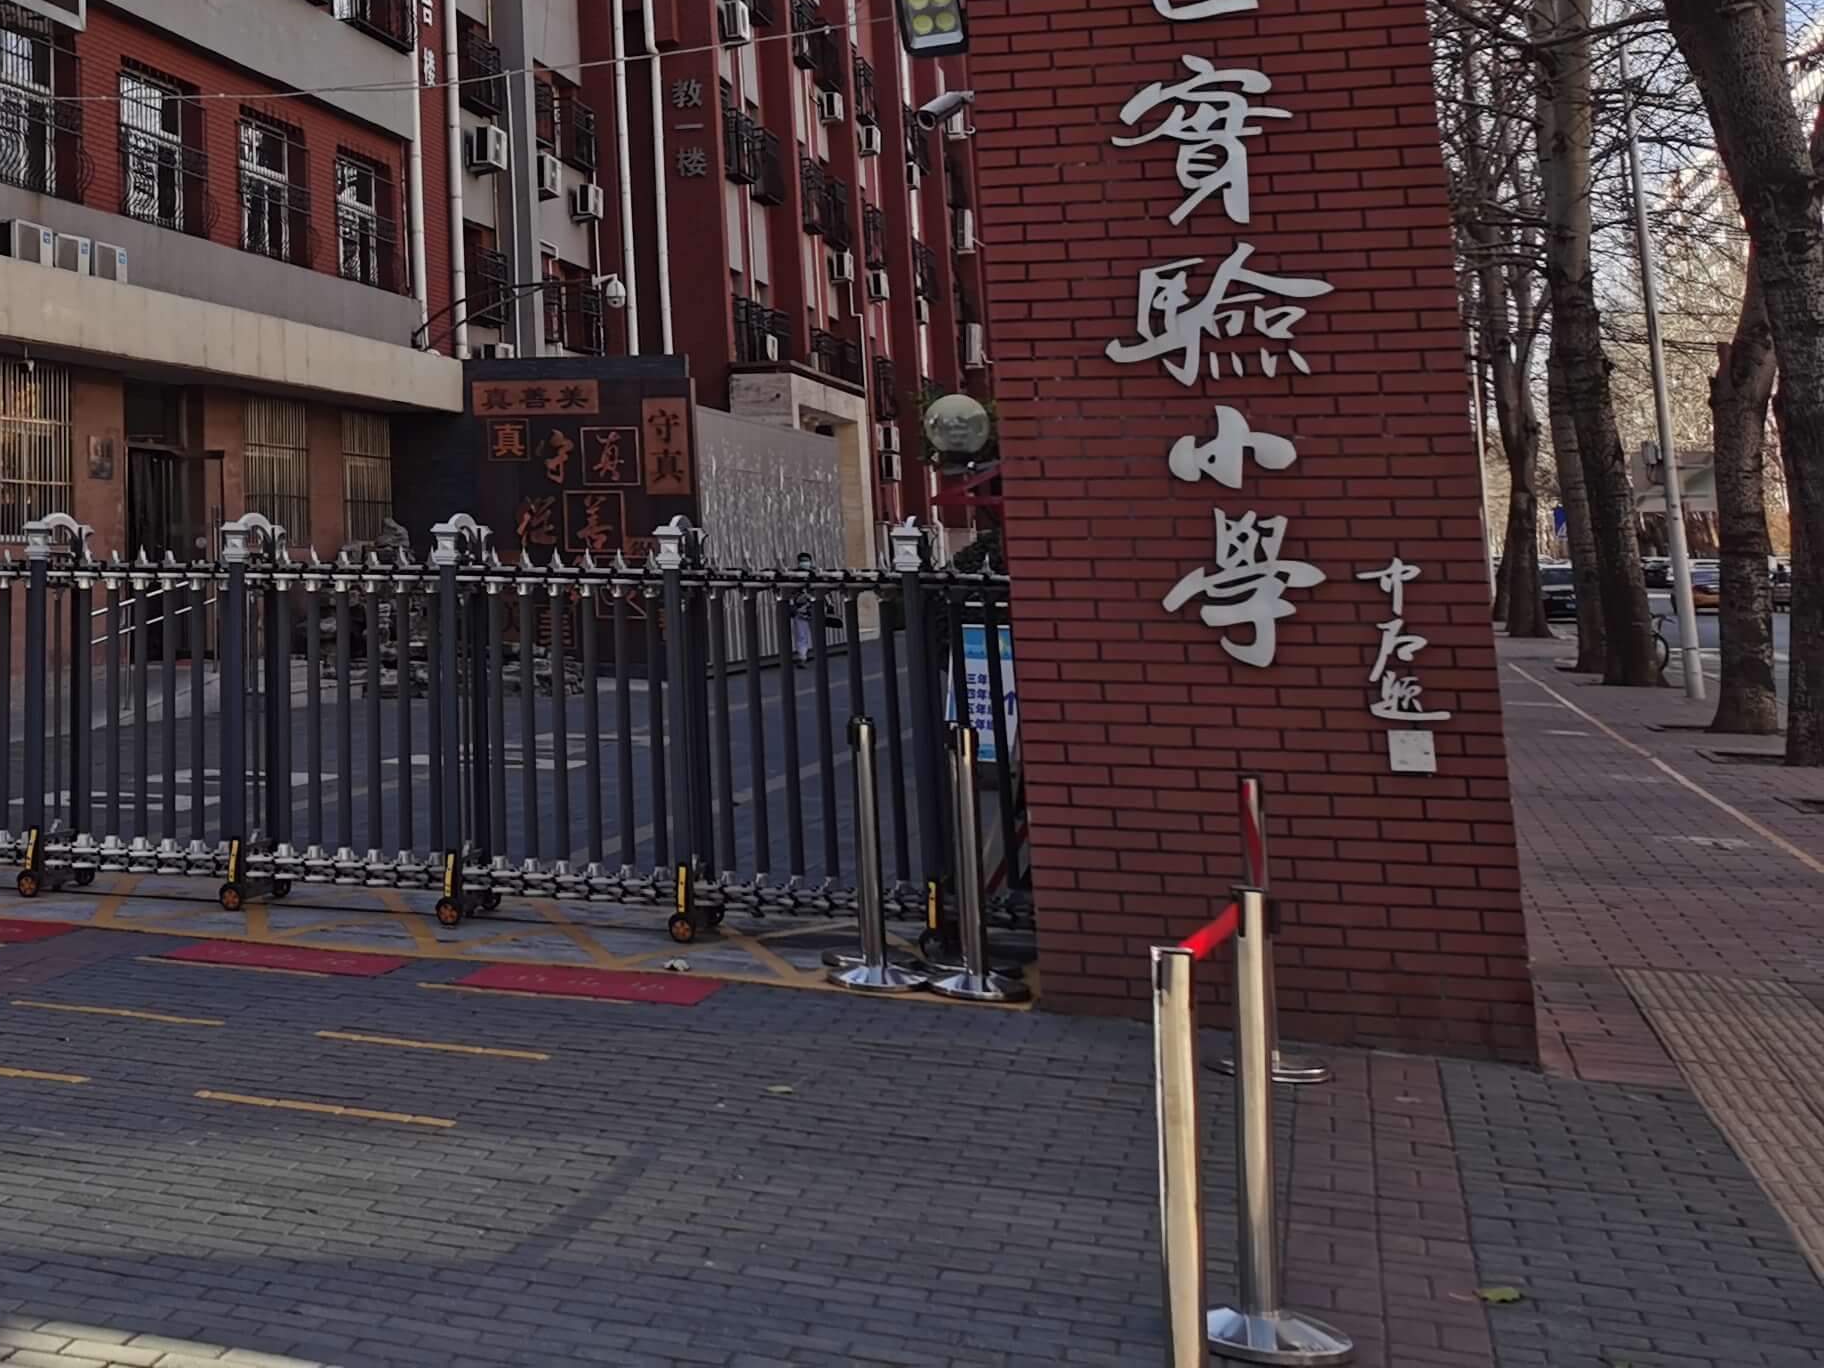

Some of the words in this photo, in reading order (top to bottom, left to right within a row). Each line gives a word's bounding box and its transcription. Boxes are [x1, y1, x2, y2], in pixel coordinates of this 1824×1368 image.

[672, 78, 707, 177] 教一楼
[492, 423, 525, 458] 真
